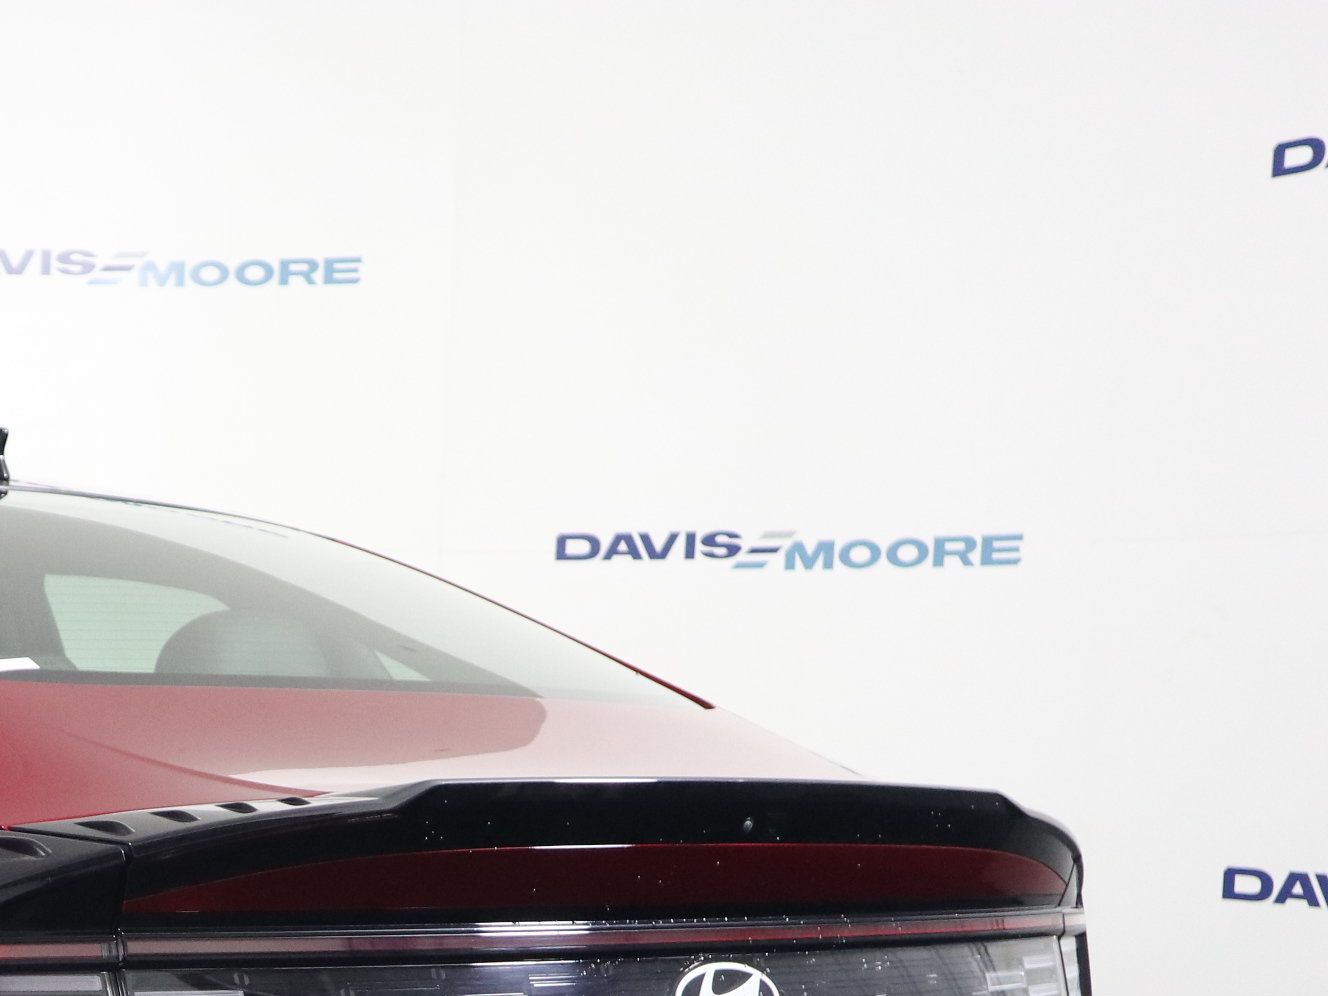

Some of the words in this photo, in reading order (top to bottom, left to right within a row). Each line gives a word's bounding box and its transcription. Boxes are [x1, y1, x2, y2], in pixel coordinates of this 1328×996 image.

[137, 256, 362, 288] MOORE
[554, 530, 742, 561] DAVIS
[783, 533, 1024, 570] MOORE
